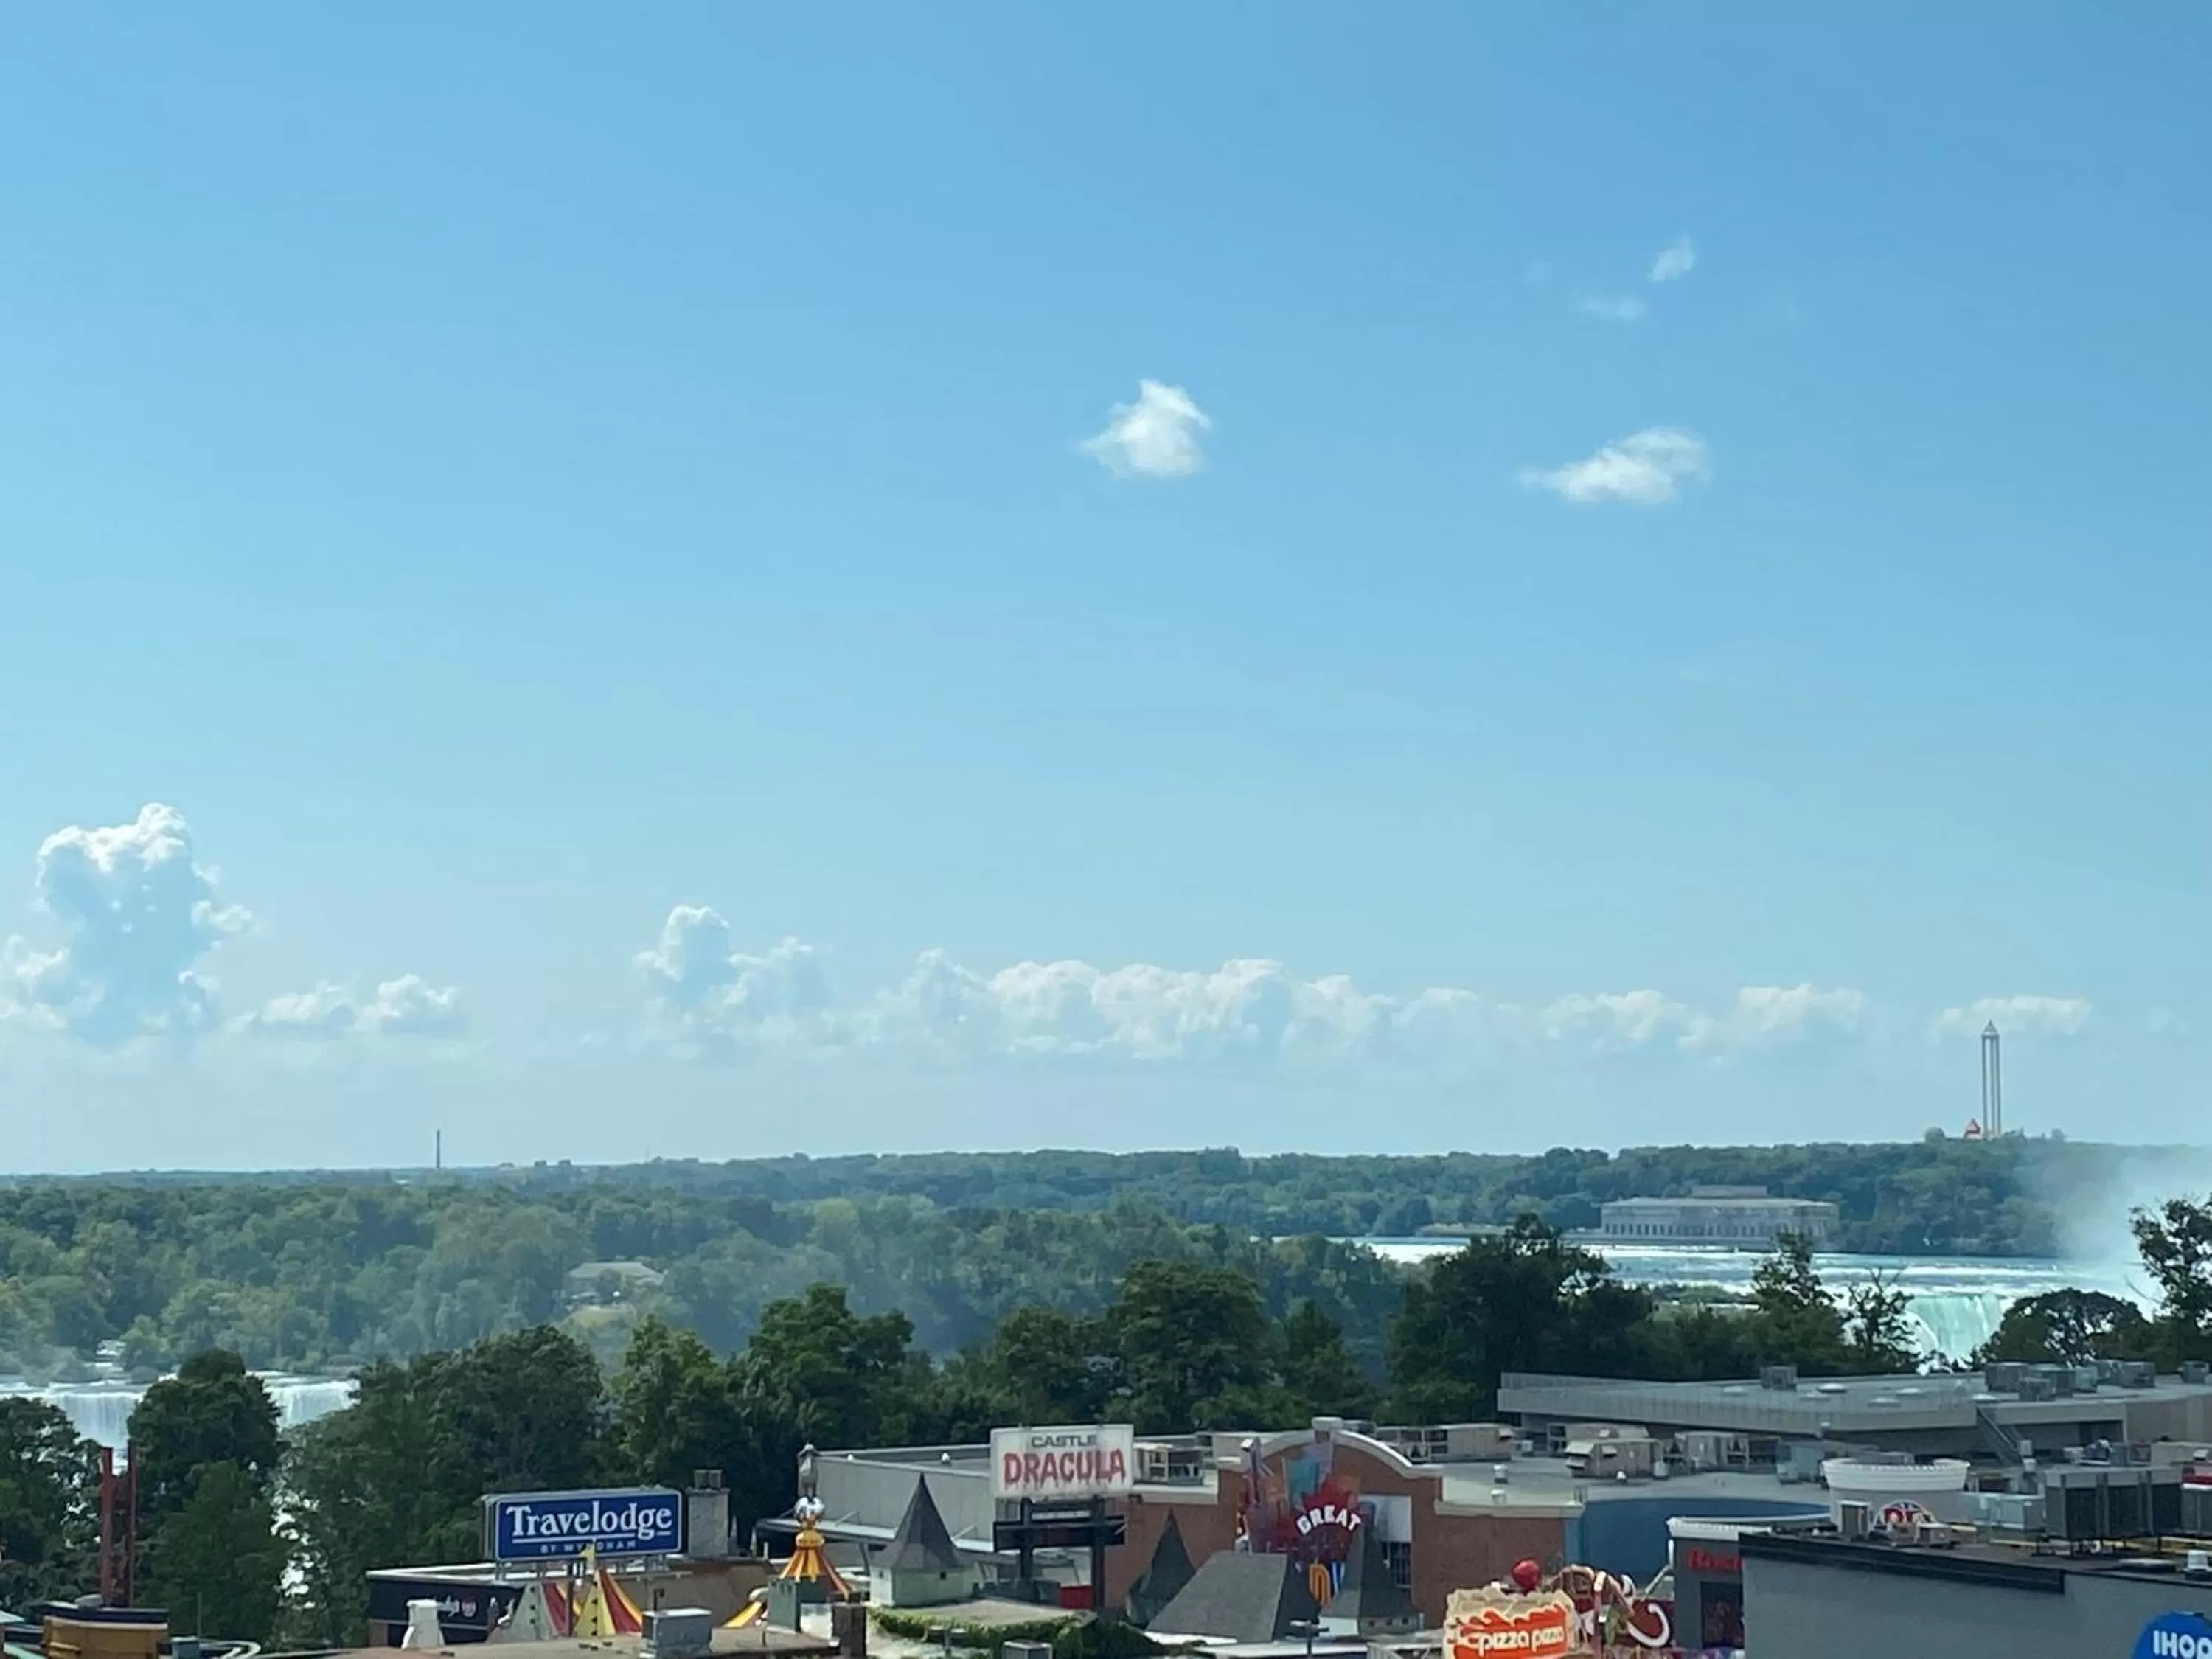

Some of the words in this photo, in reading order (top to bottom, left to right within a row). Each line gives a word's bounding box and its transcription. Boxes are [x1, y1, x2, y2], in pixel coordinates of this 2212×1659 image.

[1032, 1434, 1097, 1448] CASTLE
[1004, 1448, 1126, 1490] DRACULA
[506, 1500, 673, 1540] Travelodge
[1296, 1504, 1362, 1535] GREAT
[1478, 1630, 1530, 1658] pizza
